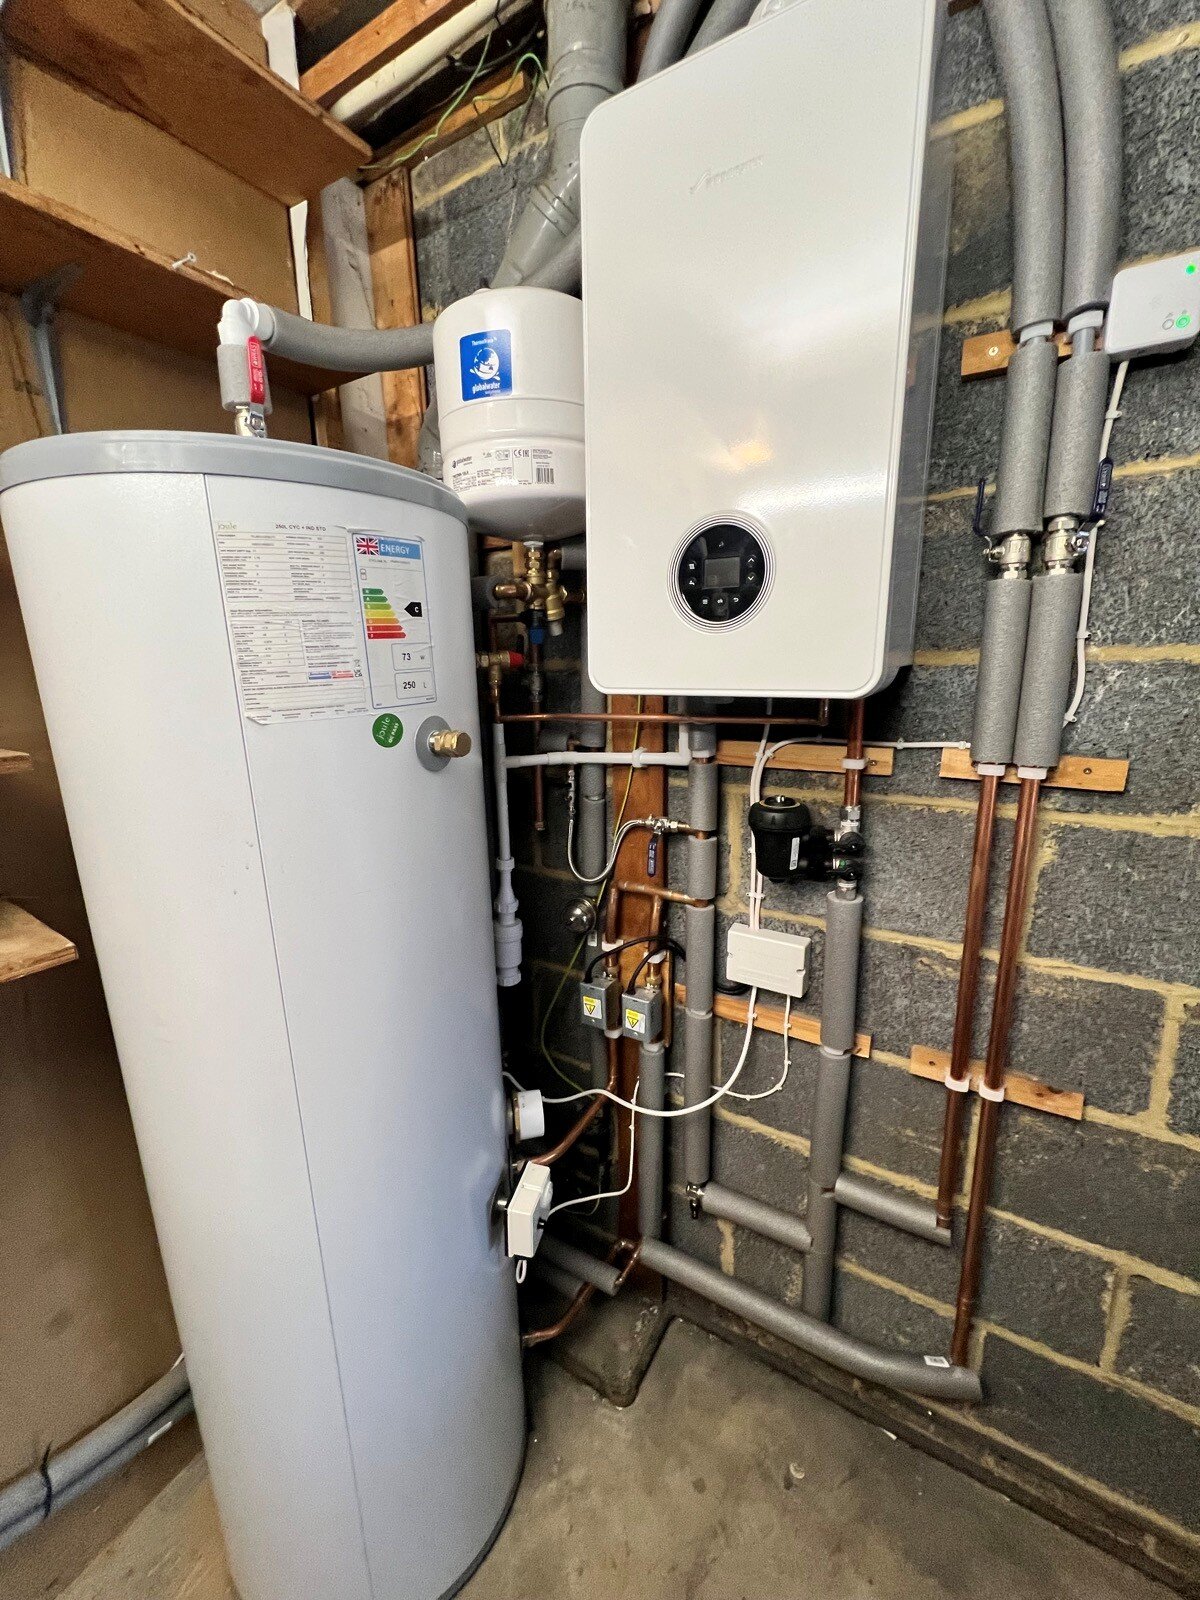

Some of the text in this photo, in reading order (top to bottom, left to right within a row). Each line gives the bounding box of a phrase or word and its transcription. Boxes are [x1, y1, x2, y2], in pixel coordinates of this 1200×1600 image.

[472, 382, 501, 395] globalwater
[380, 544, 410, 555] ENERGY
[401, 652, 412, 661] 73
[402, 680, 416, 690] 250
